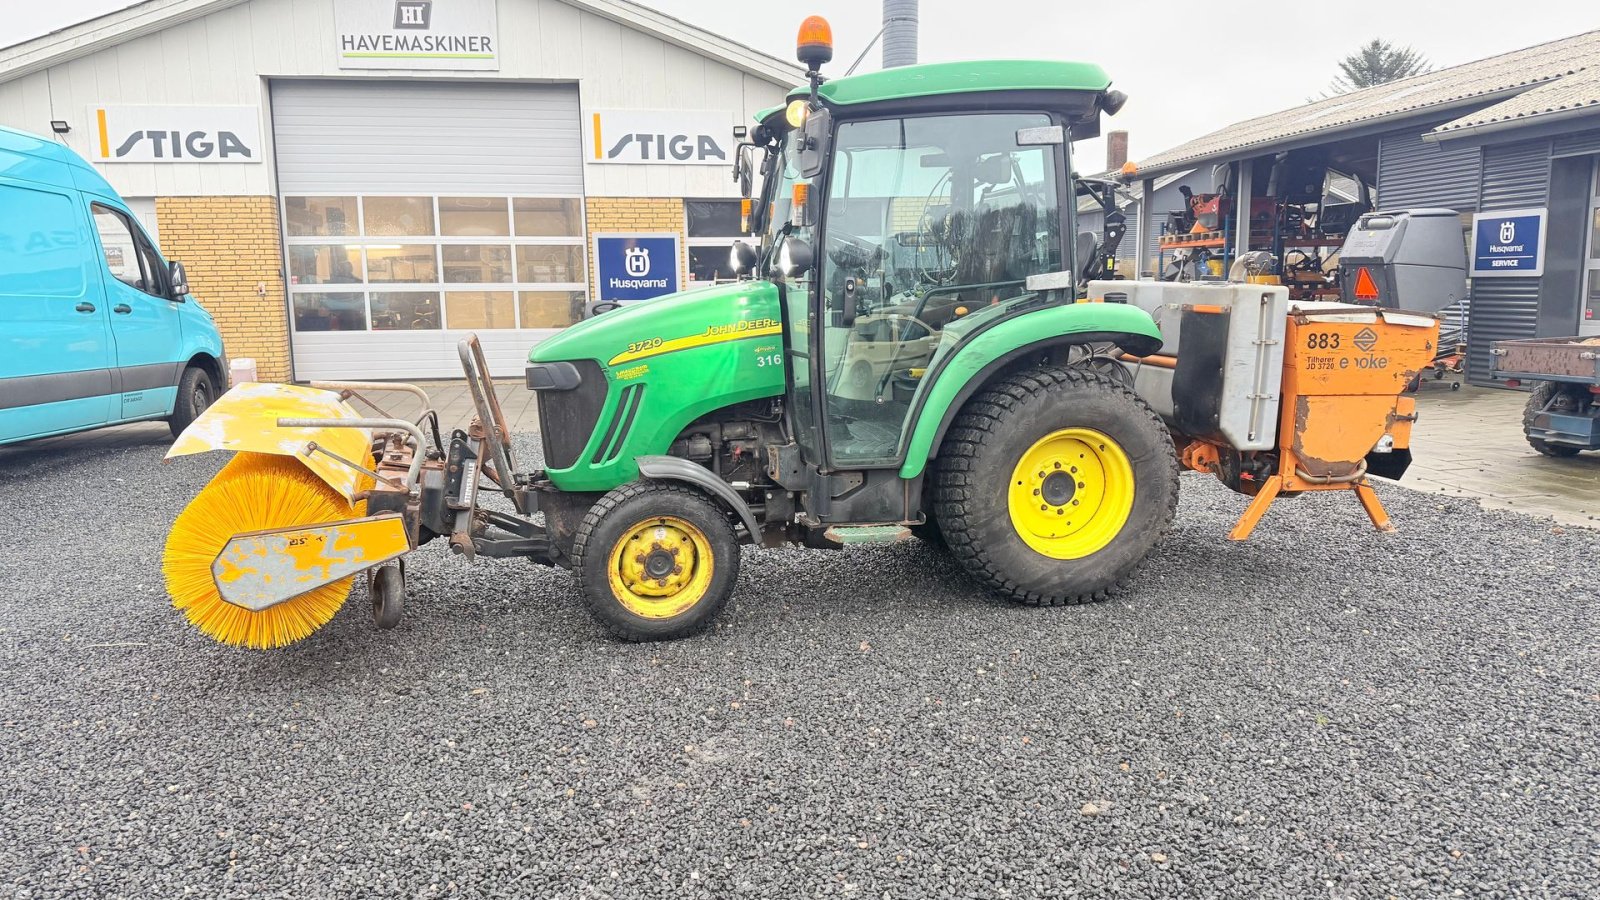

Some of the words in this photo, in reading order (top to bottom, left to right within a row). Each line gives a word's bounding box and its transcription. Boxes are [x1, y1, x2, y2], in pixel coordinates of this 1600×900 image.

[400, 6, 424, 24] HI
[341, 34, 493, 52] HAVEMASKINER
[116, 130, 252, 158] STIGA
[608, 133, 726, 161] STIGA
[1489, 245, 1523, 253] Husqvarna
[609, 278, 667, 289] Husqvarna
[702, 324, 736, 337] JOHN
[737, 318, 778, 331] DEERE
[627, 337, 663, 353] 3720
[1307, 333, 1340, 349] 883
[757, 354, 781, 367] 316
